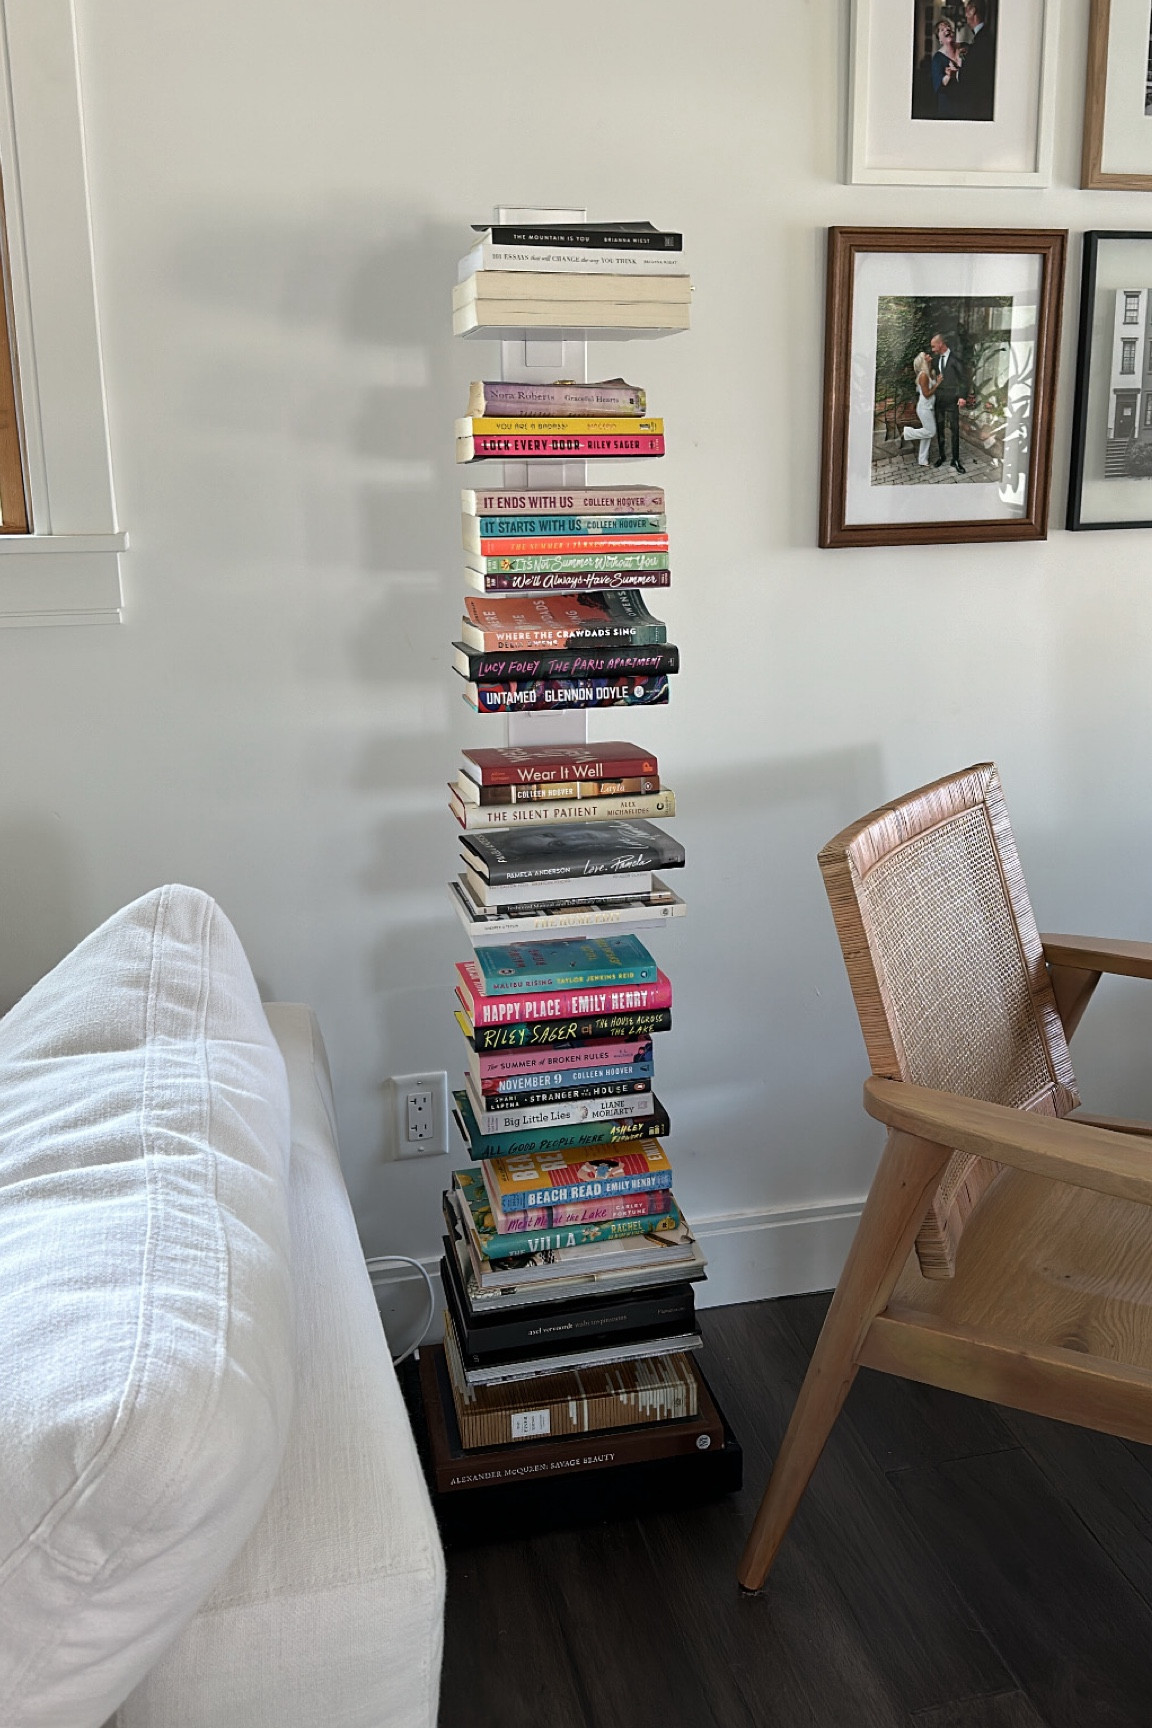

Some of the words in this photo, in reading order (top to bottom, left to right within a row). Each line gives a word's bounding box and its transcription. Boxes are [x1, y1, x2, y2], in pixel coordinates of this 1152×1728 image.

[552, 255, 580, 263] CHANGE
[490, 390, 515, 399] Nora
[517, 391, 555, 401] Roberts
[564, 394, 594, 402] Graceful
[596, 395, 620, 403] Hearts
[482, 439, 511, 451] LOCK
[514, 439, 547, 451] EVERY
[551, 439, 580, 451] DOOR
[588, 440, 611, 449] RILEY
[613, 440, 640, 449] SAGER
[484, 497, 494, 509] IT
[497, 497, 526, 509] ENDS
[528, 497, 557, 508] WITH
[560, 497, 574, 508] US
[583, 497, 615, 506] COLLEEN
[616, 497, 645, 506] HOOVER
[485, 521, 495, 533] IT
[498, 520, 536, 533] STARTS
[539, 519, 565, 532] WITH
[569, 519, 582, 531] US
[586, 520, 617, 529] COLLEEN
[619, 520, 647, 529] HOOVER
[534, 556, 554, 571] Not
[554, 556, 594, 571] Summer
[594, 555, 633, 570] Without
[634, 553, 658, 570] You
[512, 574, 541, 588] We'll
[543, 574, 583, 588] Always
[581, 574, 611, 585] Have
[610, 573, 657, 588] Summer
[496, 632, 531, 641] WHERE
[533, 631, 553, 640] THE
[556, 629, 610, 639] CRAWDADS
[612, 628, 637, 636] SING
[498, 640, 524, 649] DELIA
[527, 639, 559, 648] OWENS
[478, 661, 505, 678] LUCY
[508, 659, 541, 676] FOLEY
[548, 659, 570, 673] THE
[571, 657, 604, 674] PARIS
[606, 655, 664, 670] APARTMENT
[486, 690, 537, 705] UNTAMED
[544, 687, 594, 703] GLENNON
[596, 685, 629, 700] DOYLE
[517, 767, 557, 782] Wear
[560, 766, 569, 779] It
[571, 762, 603, 778] Well
[517, 789, 546, 799] COLLEEN
[548, 787, 574, 797] HOOVER
[600, 783, 625, 795] Layla
[487, 811, 508, 822] THE
[512, 809, 548, 821] SILENT
[553, 806, 598, 818] PATIENT
[607, 807, 649, 816] MICHAELIDES
[604, 854, 652, 872] Pamela
[506, 871, 533, 879] PAMELA
[534, 867, 571, 876] ANDERSON
[534, 919, 558, 928] THE
[493, 981, 523, 990] MALIBU
[525, 978, 553, 988] RISING
[556, 975, 584, 985] TAYLOR
[586, 973, 616, 983] JENKINS
[618, 972, 635, 980] REID
[571, 993, 607, 1014] EMILY
[611, 989, 649, 1010] HENRY
[482, 1002, 521, 1023] HAPPY
[525, 998, 561, 1019] PLACE
[595, 1019, 608, 1029] THE
[610, 1015, 634, 1027] HOUSE
[635, 1013, 664, 1024] ACROSS
[483, 1029, 528, 1048] RILEY
[532, 1022, 579, 1042] SAGER
[611, 1027, 625, 1036] THE
[628, 1024, 655, 1035] LAKE
[487, 1064, 499, 1072] The
[500, 1059, 536, 1070] SUMMER
[539, 1058, 546, 1066] of
[548, 1054, 581, 1065] BROKEN
[583, 1052, 609, 1061] RULES
[572, 1070, 604, 1080] COLLEEN
[605, 1066, 633, 1078] HOOVER
[499, 1076, 551, 1091] NOVEMBER
[554, 1073, 563, 1084] 9
[495, 1095, 517, 1103] SHARI
[530, 1090, 580, 1103] STRANGER
[593, 1084, 629, 1095] HOUSE
[490, 1102, 519, 1110] LAPENA
[600, 1100, 625, 1110] LIANE
[592, 1106, 636, 1118] MORIARTY
[504, 1117, 520, 1127] Big
[522, 1113, 549, 1125] Little
[550, 1111, 571, 1120] Lies
[610, 1123, 644, 1135] ASHLEY
[481, 1144, 505, 1157] ALL
[507, 1142, 536, 1155] GOOD
[540, 1136, 575, 1149] PEOPLE
[578, 1133, 605, 1144] HERE
[606, 1179, 630, 1192] EMILY
[631, 1176, 656, 1188] HENRY
[527, 1189, 568, 1206] BEACH
[571, 1184, 603, 1200] READ
[507, 1216, 534, 1231] Meet
[533, 1214, 548, 1227] Me
[553, 1215, 563, 1224] at
[566, 1213, 580, 1221] the
[580, 1207, 607, 1221] Lake
[612, 1208, 646, 1217] FORTUNE
[611, 1220, 643, 1233] RACHEL
[527, 1232, 577, 1252] VILLA
[450, 1470, 502, 1485] ALEXANDER
[550, 1458, 580, 1470] SAVAGE
[583, 1453, 616, 1465] BEAUTY
